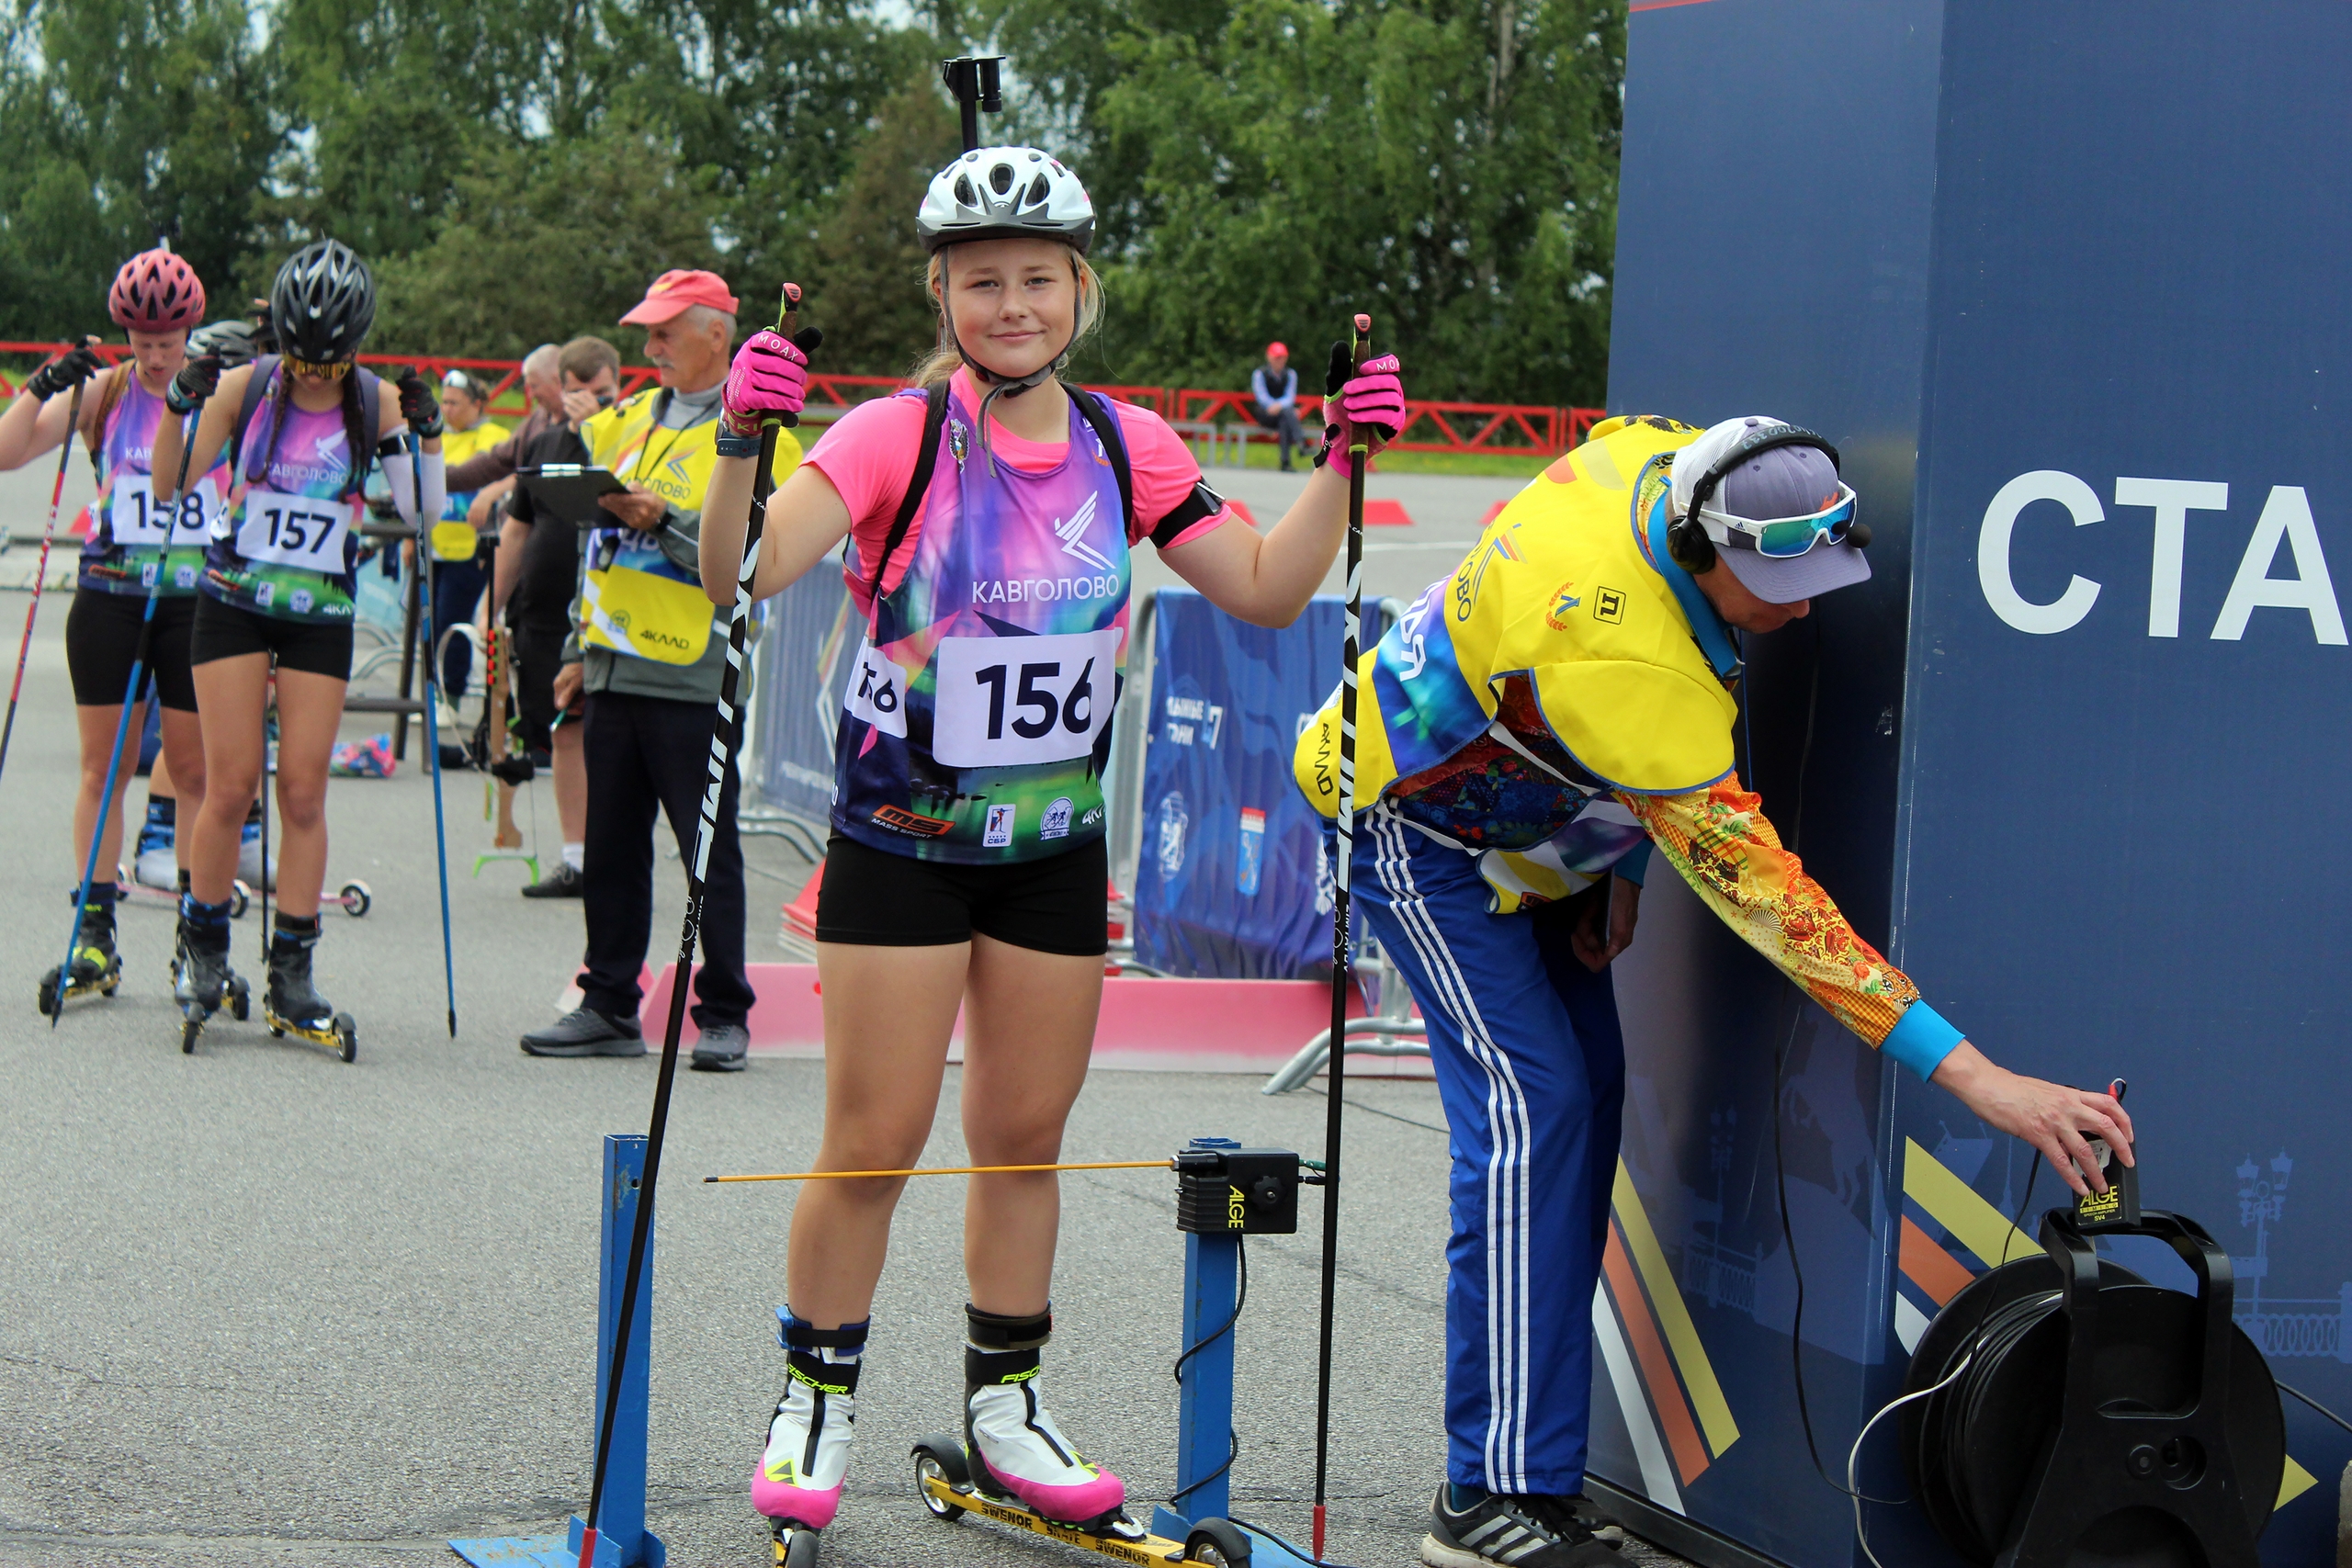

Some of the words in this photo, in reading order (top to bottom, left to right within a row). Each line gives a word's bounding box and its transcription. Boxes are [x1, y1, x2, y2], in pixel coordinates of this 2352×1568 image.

[758, 333, 798, 361] MOAX
[727, 412, 758, 432] EKI
[130, 489, 205, 530] 158
[265, 507, 336, 554] 157
[1977, 469, 2349, 646] СТА
[972, 574, 1119, 604] КАВГОЛОВО
[975, 655, 1095, 739] 156
[871, 818, 899, 831] MASS
[899, 828, 933, 839] SPORT
[1228, 1185, 1245, 1228] ALGE
[2080, 1185, 2119, 1208] ALGE
[787, 1363, 848, 1394] FISCHER
[1001, 1365, 1040, 1384] FISC
[981, 1502, 1033, 1529] SWENOR
[1095, 1539, 1150, 1565] SWENOR
